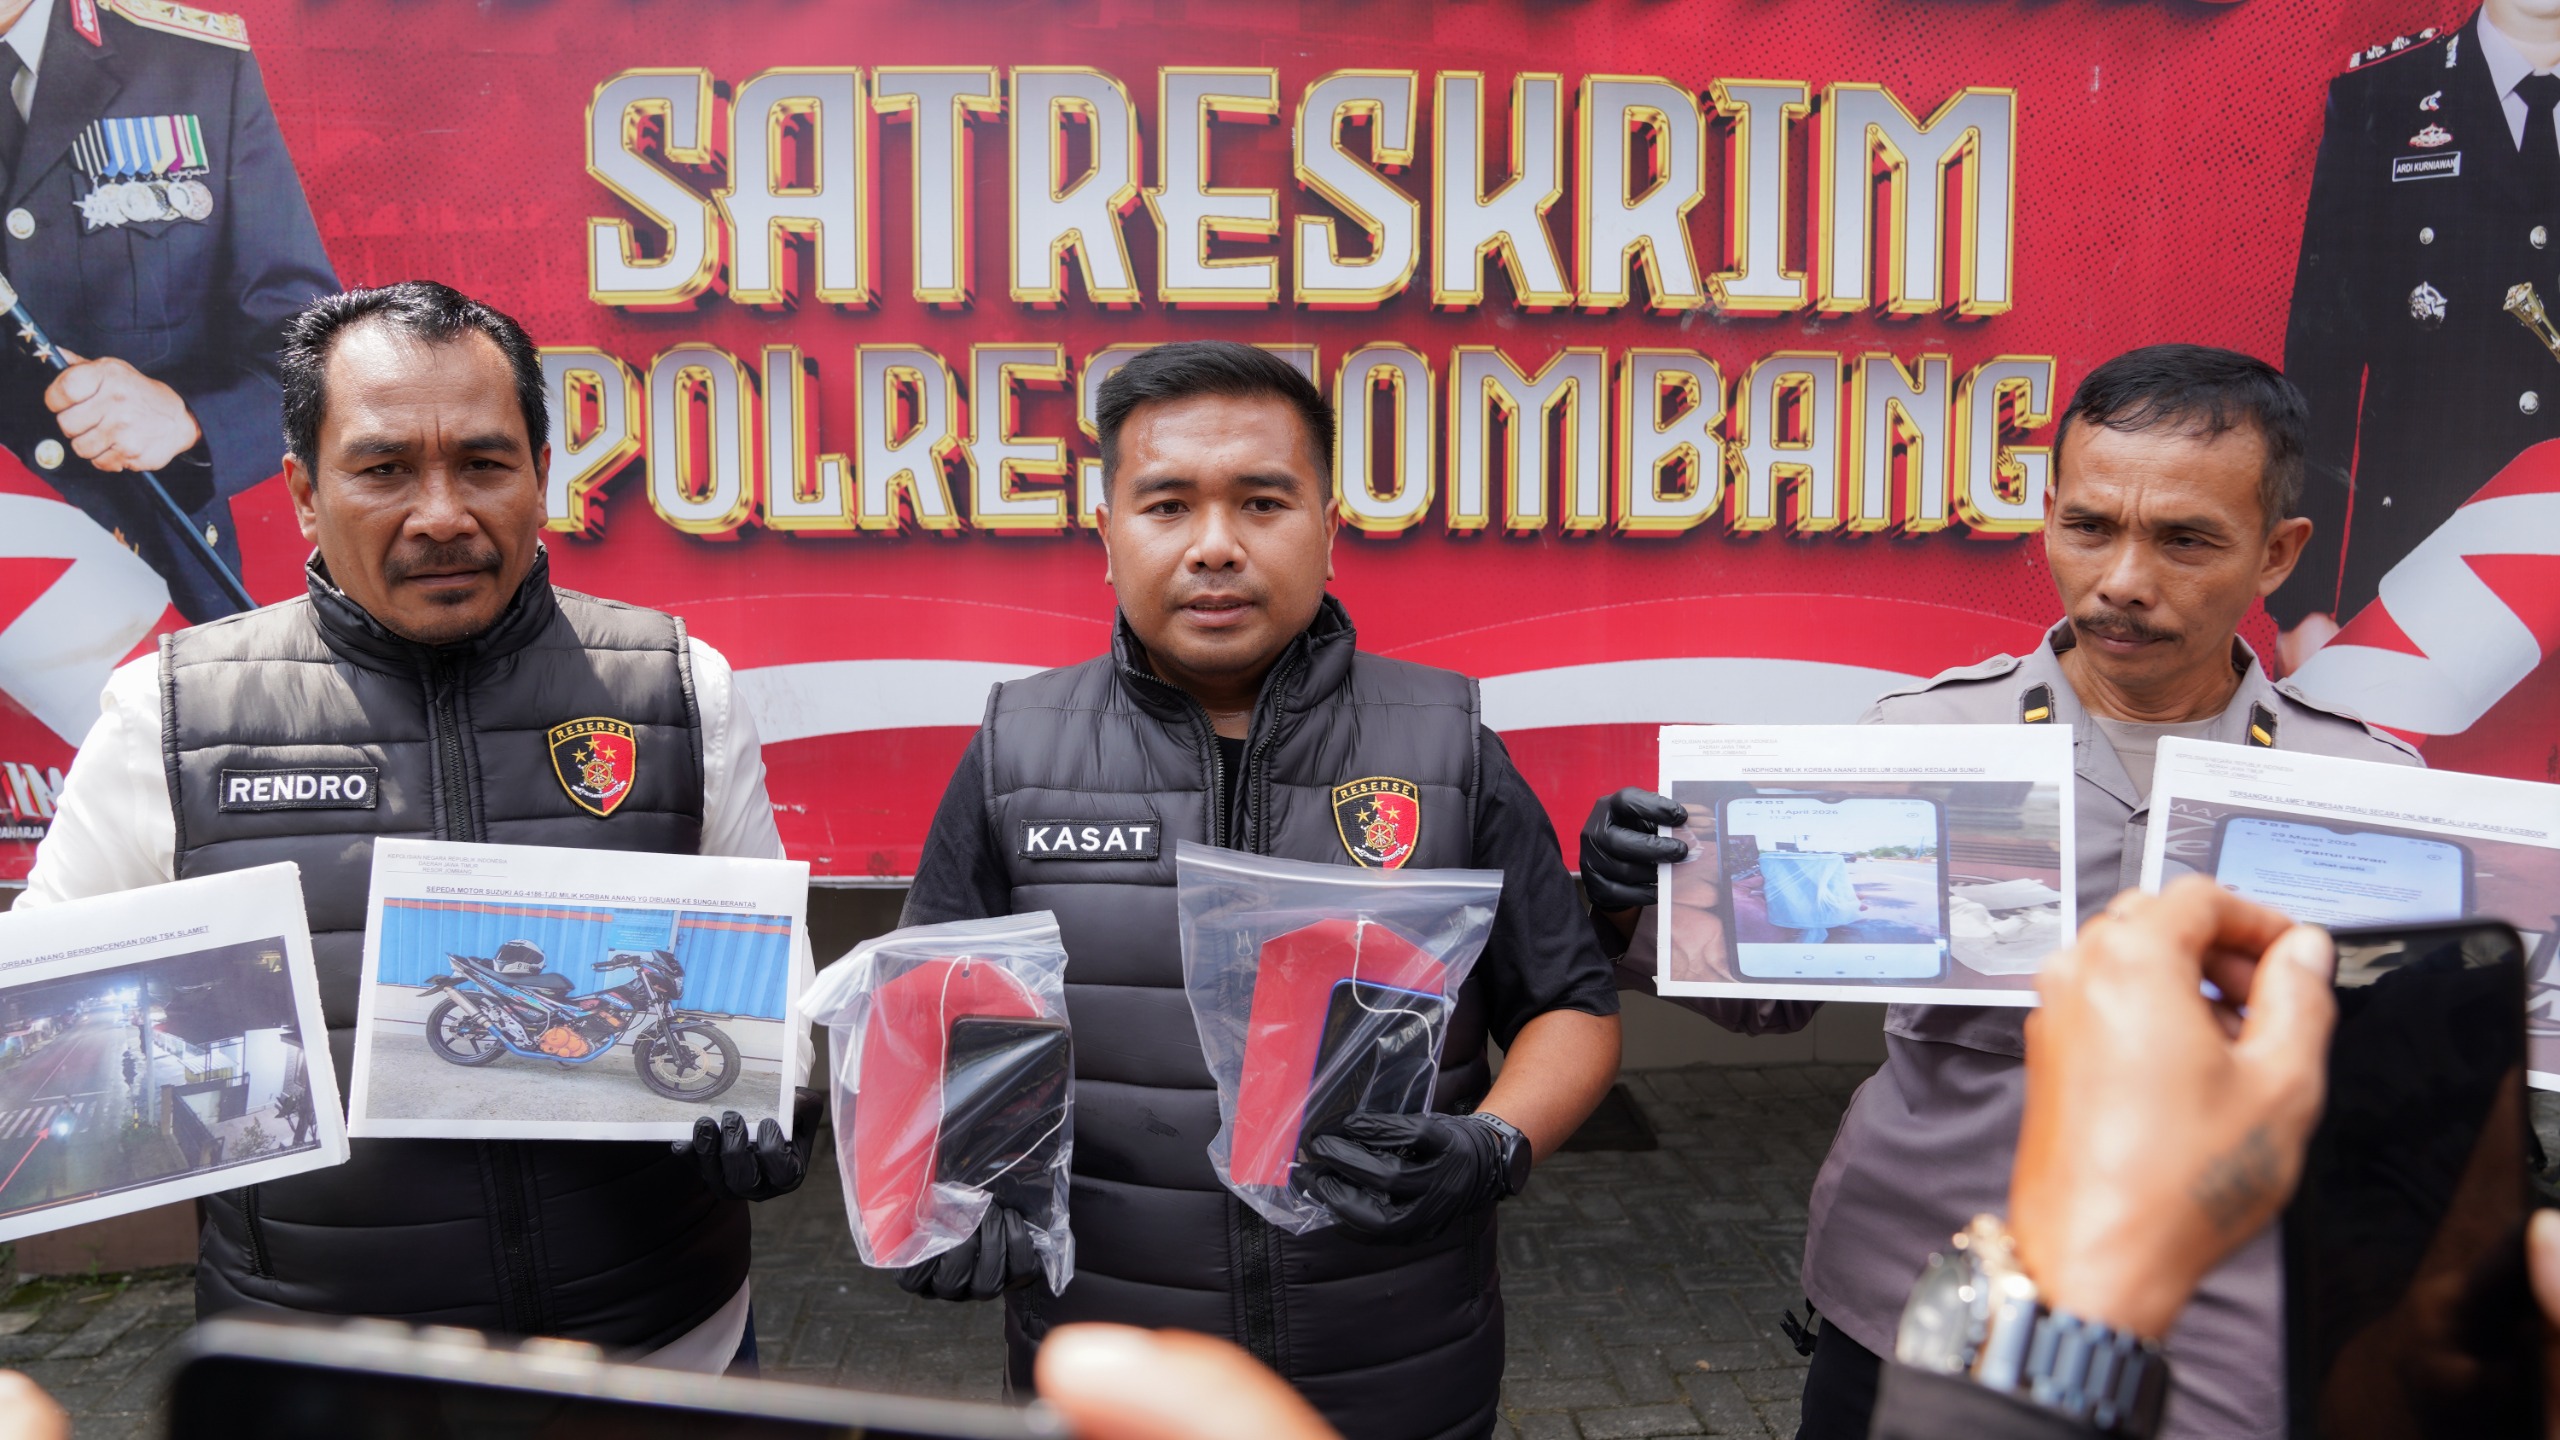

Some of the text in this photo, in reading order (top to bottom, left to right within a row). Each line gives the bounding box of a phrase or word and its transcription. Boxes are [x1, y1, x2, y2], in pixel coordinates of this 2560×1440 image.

[2396, 158, 2456, 174] ARDI KURNIAWAN
[586, 66, 2017, 316] SATRESKRIM
[1264, 341, 2057, 534] OMBANG
[555, 721, 626, 740] RESERSE
[228, 775, 368, 803] RENDRO
[1340, 781, 1411, 799] RESERSE
[2229, 790, 2273, 802] TERSANGKA
[2275, 796, 2305, 805] SLAMET
[2504, 826, 2548, 837] FACEBOOK
[0, 826, 45, 839] AHARJA
[1027, 826, 1150, 851] KASAT
[2288, 834, 2323, 843] Maret
[426, 885, 456, 894] SEPEDA
[457, 887, 484, 895] MOTOR
[485, 888, 512, 897] SUZUKI
[559, 891, 578, 899] MILIK
[579, 892, 610, 901] KORBAN
[611, 894, 636, 902] ANANG
[649, 896, 680, 904] DIBUANG
[693, 898, 719, 906] SUNGAI
[720, 900, 757, 908] BERANTAS
[0, 924, 209, 970] ORBAN ANANG BERBONCENGAN DGN TSK SLAMET
